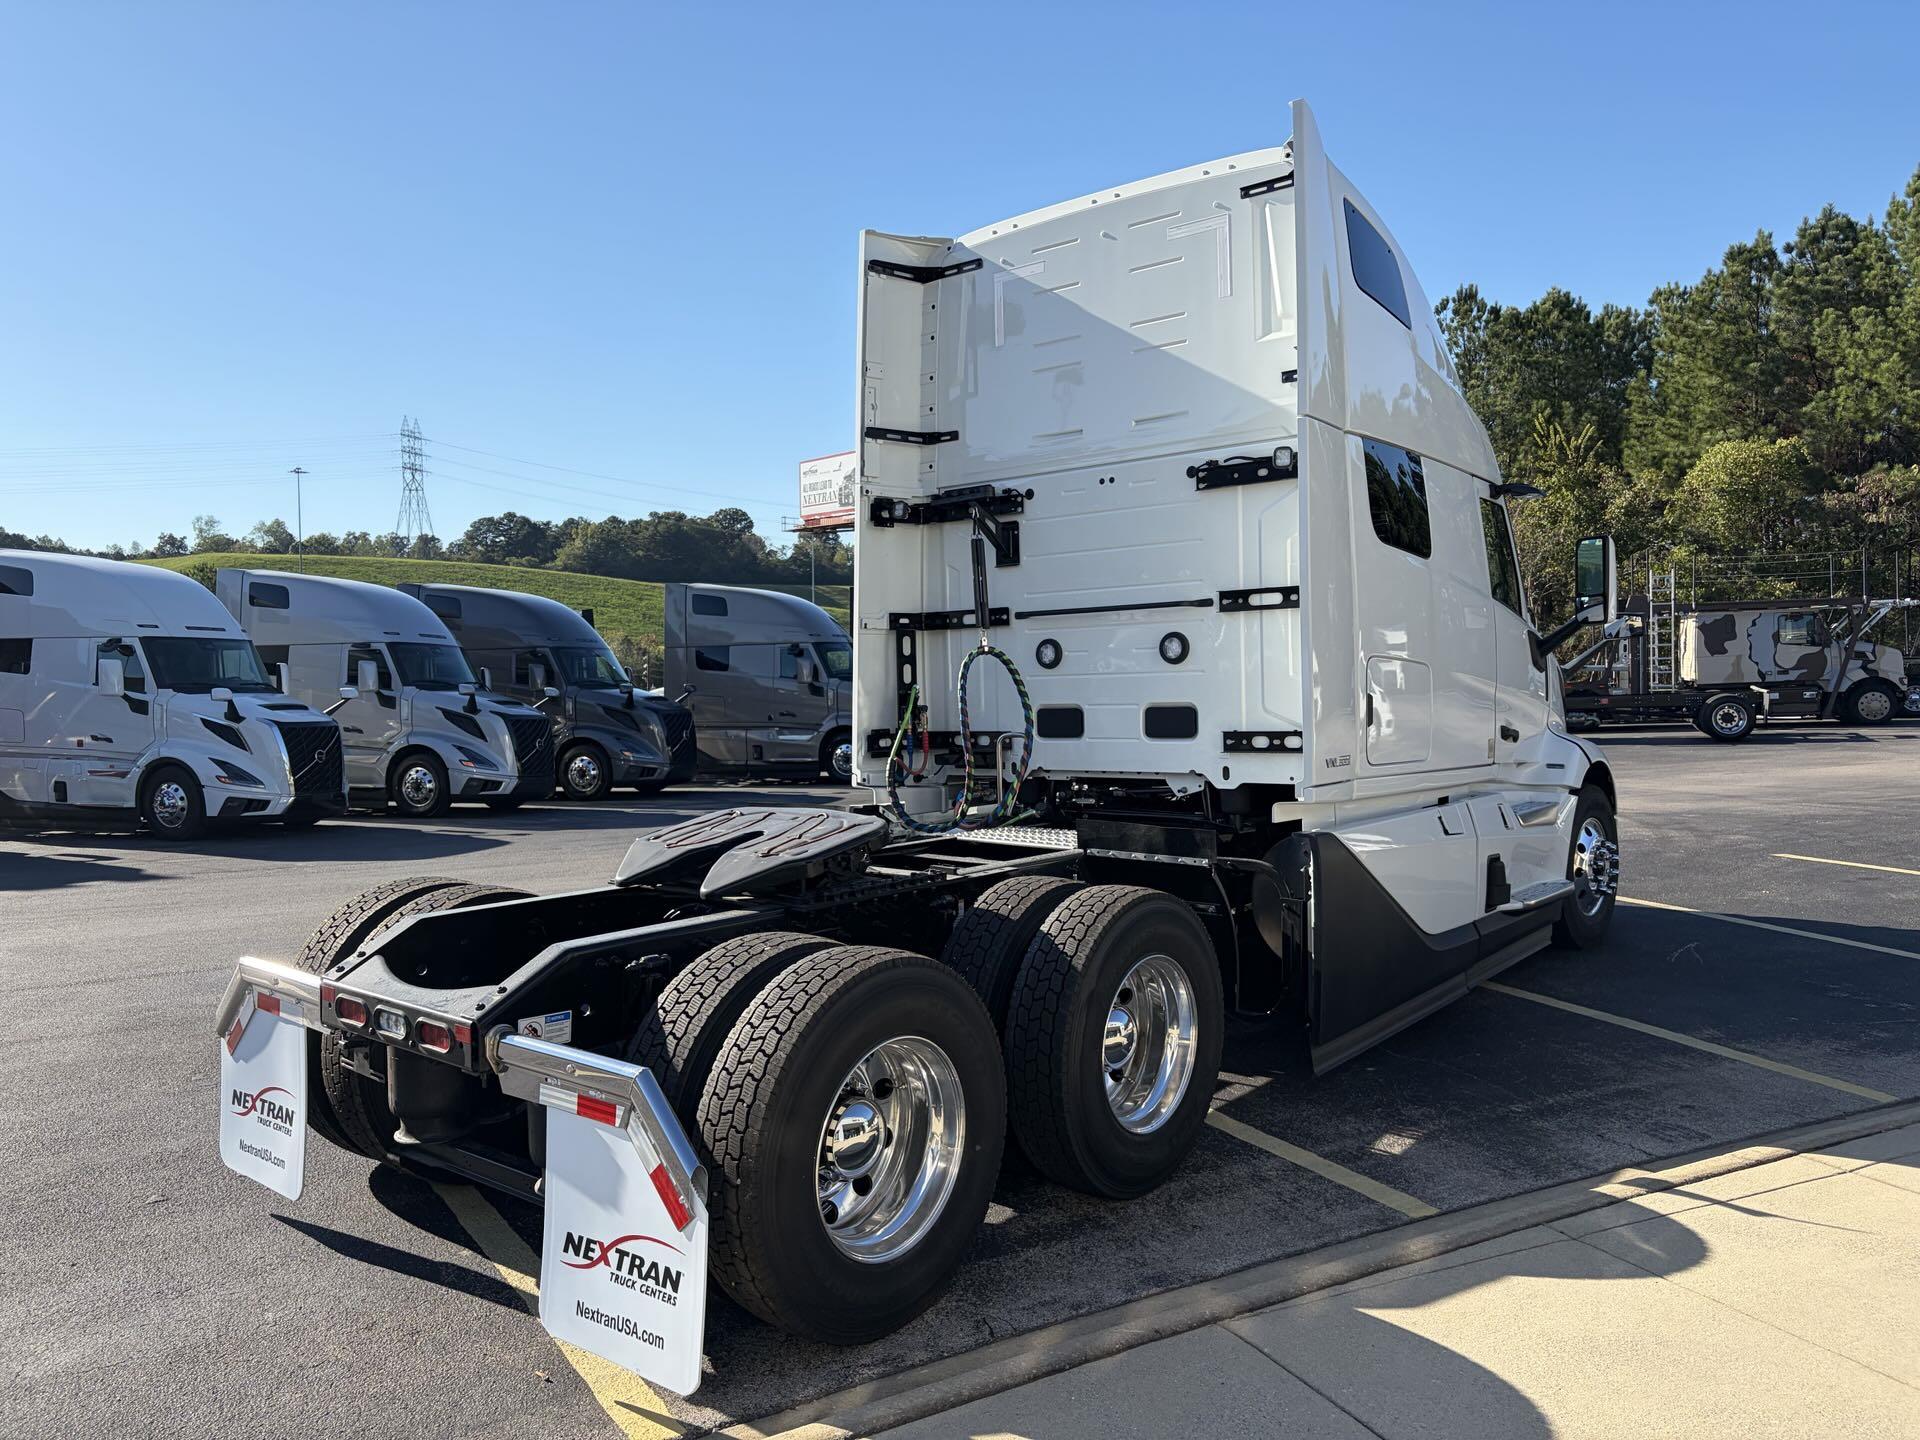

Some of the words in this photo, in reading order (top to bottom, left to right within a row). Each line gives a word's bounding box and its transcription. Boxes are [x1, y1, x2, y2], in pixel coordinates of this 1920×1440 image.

[231, 1087, 296, 1127] NEXTRAN
[257, 1116, 271, 1129] TRUCK
[272, 1122, 292, 1137] CENTERS
[239, 1138, 286, 1170] NextranUSA.com
[560, 1231, 684, 1294] NEXTRAN
[609, 1271, 638, 1291] TRUCK
[639, 1283, 678, 1307] CENTERS
[576, 1299, 665, 1351] NextranUSA.com
